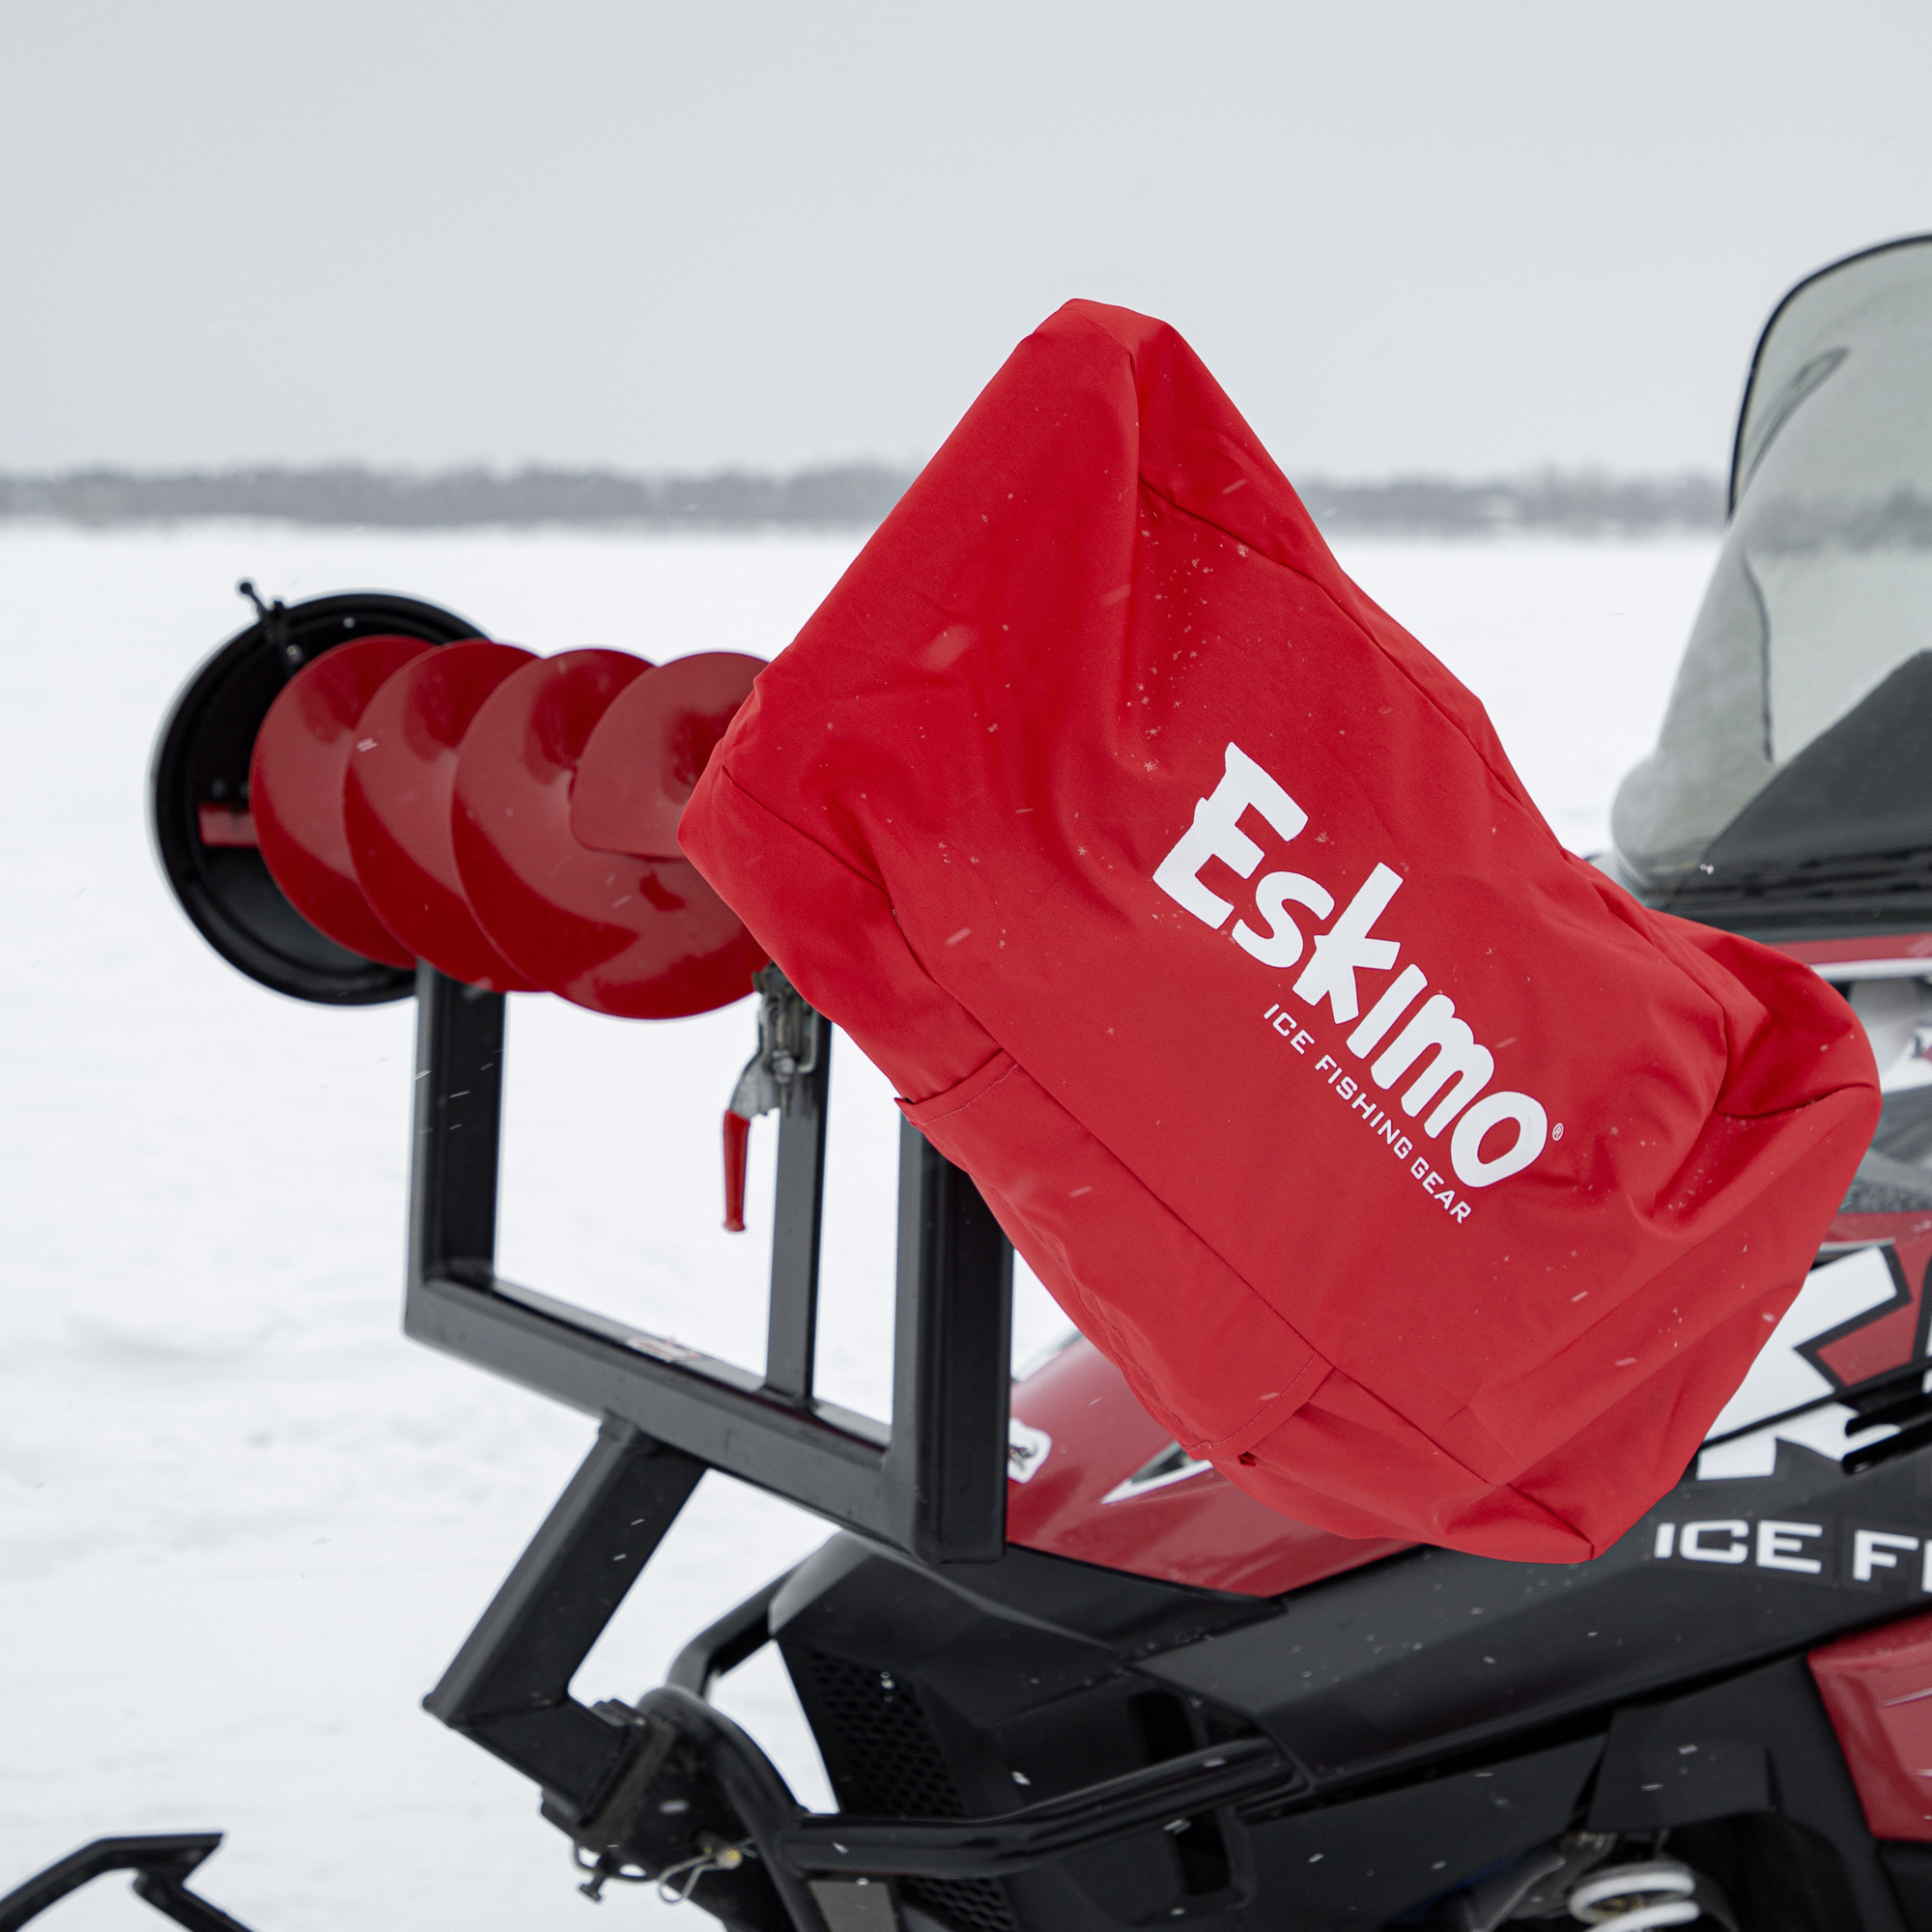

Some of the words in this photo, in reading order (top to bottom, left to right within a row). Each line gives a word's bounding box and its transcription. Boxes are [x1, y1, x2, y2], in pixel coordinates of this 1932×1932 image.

[1263, 1003, 1316, 1055] ICE
[1314, 1054, 1413, 1160] FISHING
[1410, 1156, 1471, 1224] GEAR
[1654, 1520, 1823, 1575] ICE
